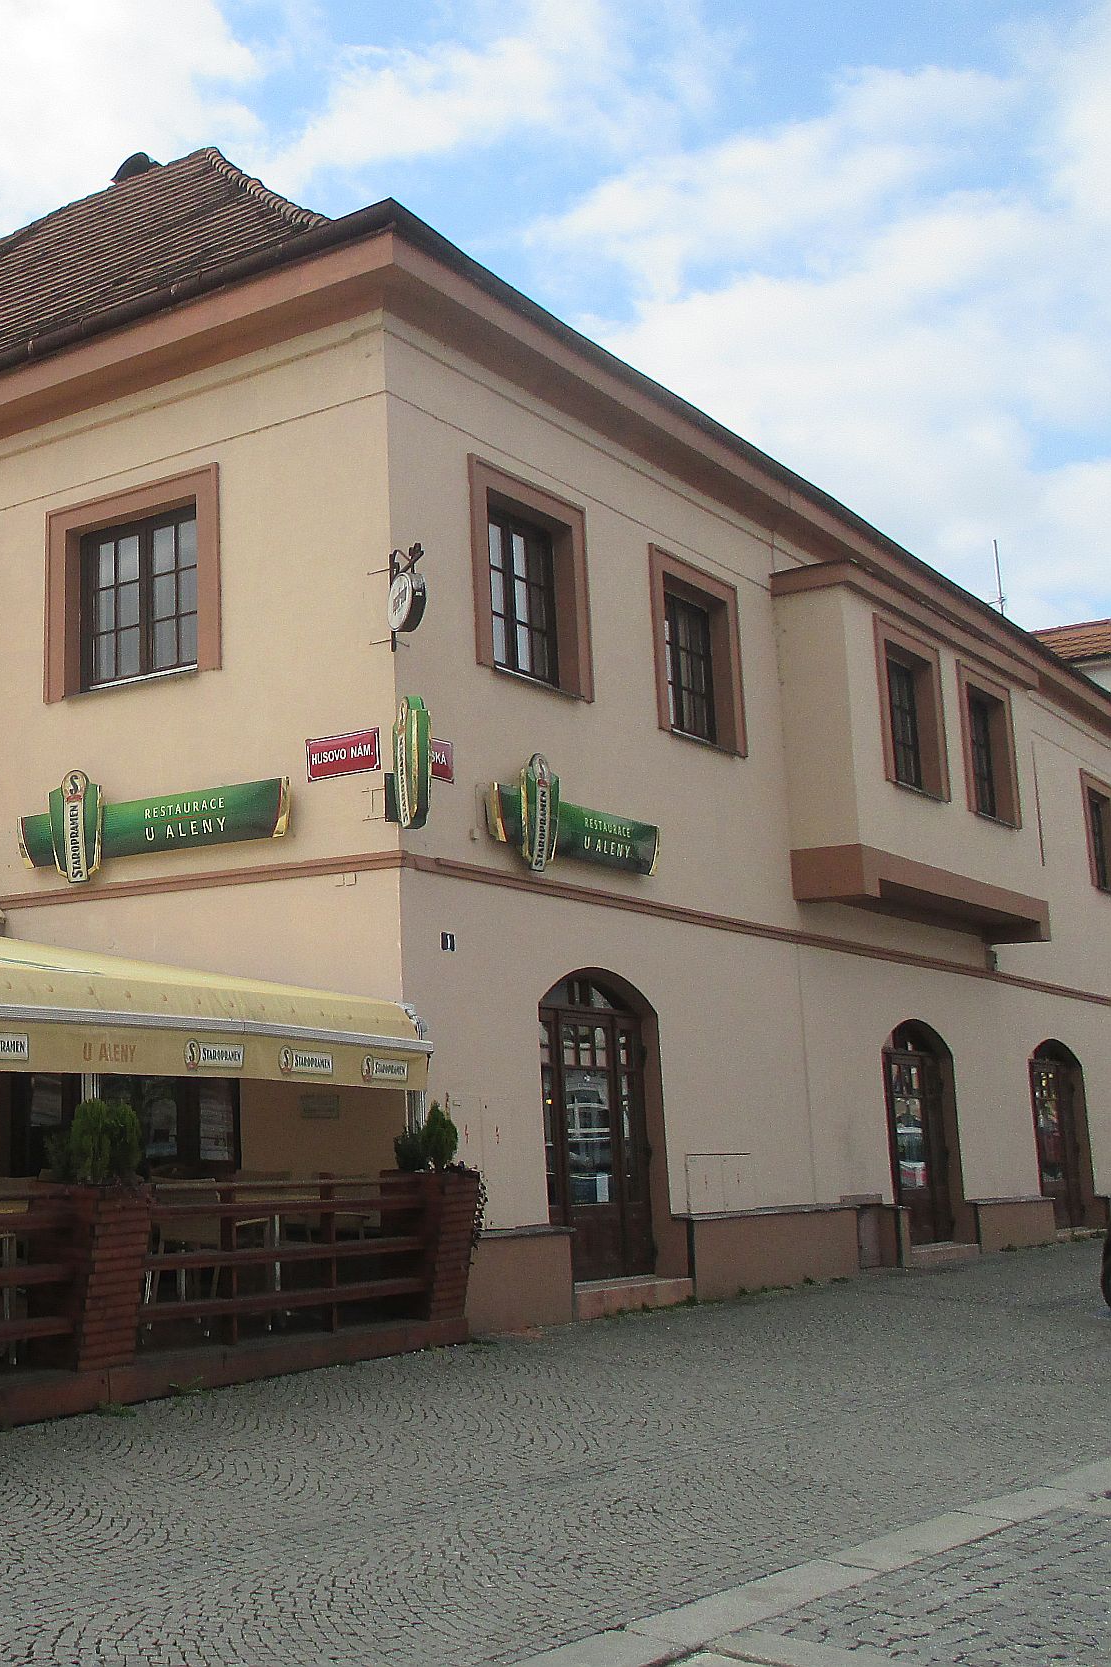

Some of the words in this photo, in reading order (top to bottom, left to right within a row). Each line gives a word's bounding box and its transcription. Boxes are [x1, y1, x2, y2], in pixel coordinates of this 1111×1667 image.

[311, 747, 347, 766] HUSOVO
[350, 742, 374, 759] NÁM.
[431, 750, 447, 766] SKÁ
[144, 797, 225, 819] RESTAURACE
[145, 826, 155, 841] U
[165, 816, 227, 839] ALENY
[534, 790, 548, 867] STAROPRAMEN
[584, 817, 632, 838] RESTAURACE
[66, 804, 84, 878] STAROPRAMEN
[584, 836, 591, 850] U
[595, 839, 632, 859] ALENY
[447, 934, 451, 949] 1
[83, 1042, 93, 1062] U
[98, 1041, 137, 1063] ALENY
[202, 1047, 242, 1063] STAROPRAMEN
[294, 1054, 332, 1070] STAROPRAMEN
